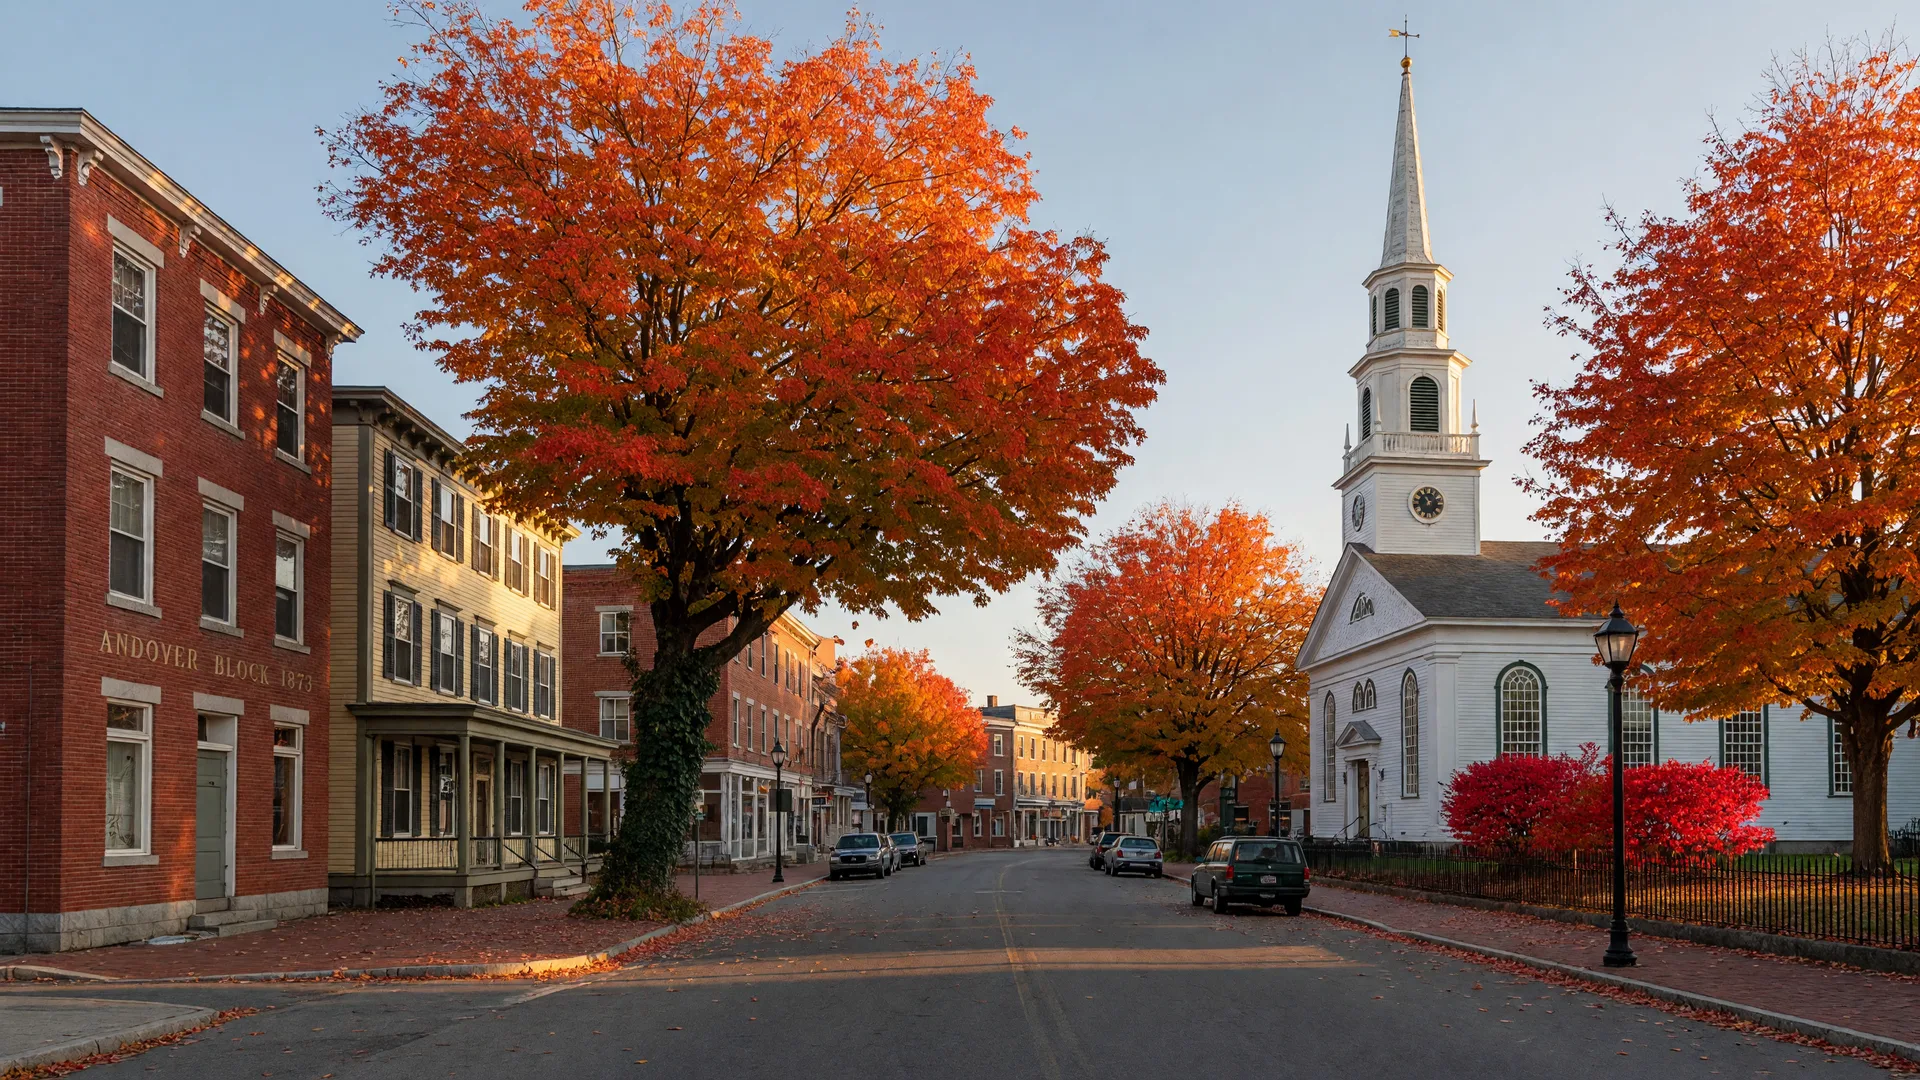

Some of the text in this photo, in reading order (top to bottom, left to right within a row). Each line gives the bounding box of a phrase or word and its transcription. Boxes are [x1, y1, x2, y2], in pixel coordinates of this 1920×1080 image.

[99, 630, 312, 692] ANDOVER BLOCK 1873
